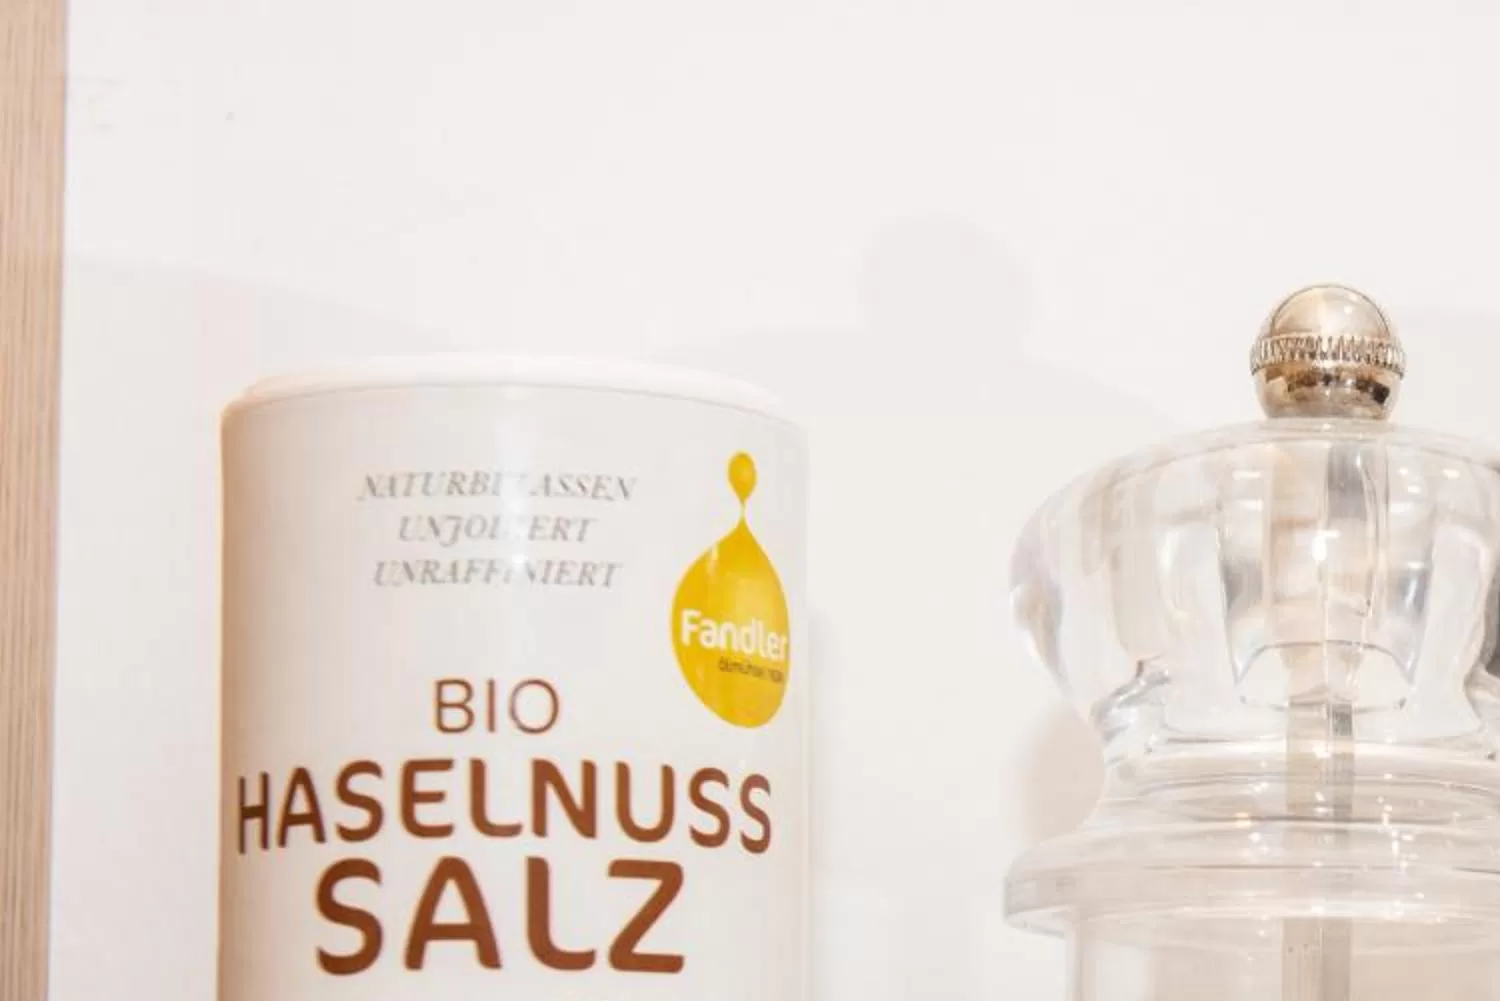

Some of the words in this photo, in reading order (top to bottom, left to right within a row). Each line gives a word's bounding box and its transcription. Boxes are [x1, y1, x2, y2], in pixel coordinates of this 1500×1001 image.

[681, 608, 787, 660] Fandler
[435, 678, 560, 734] BIO
[237, 758, 773, 853] HASELNUSS
[316, 856, 686, 976] SALZ
